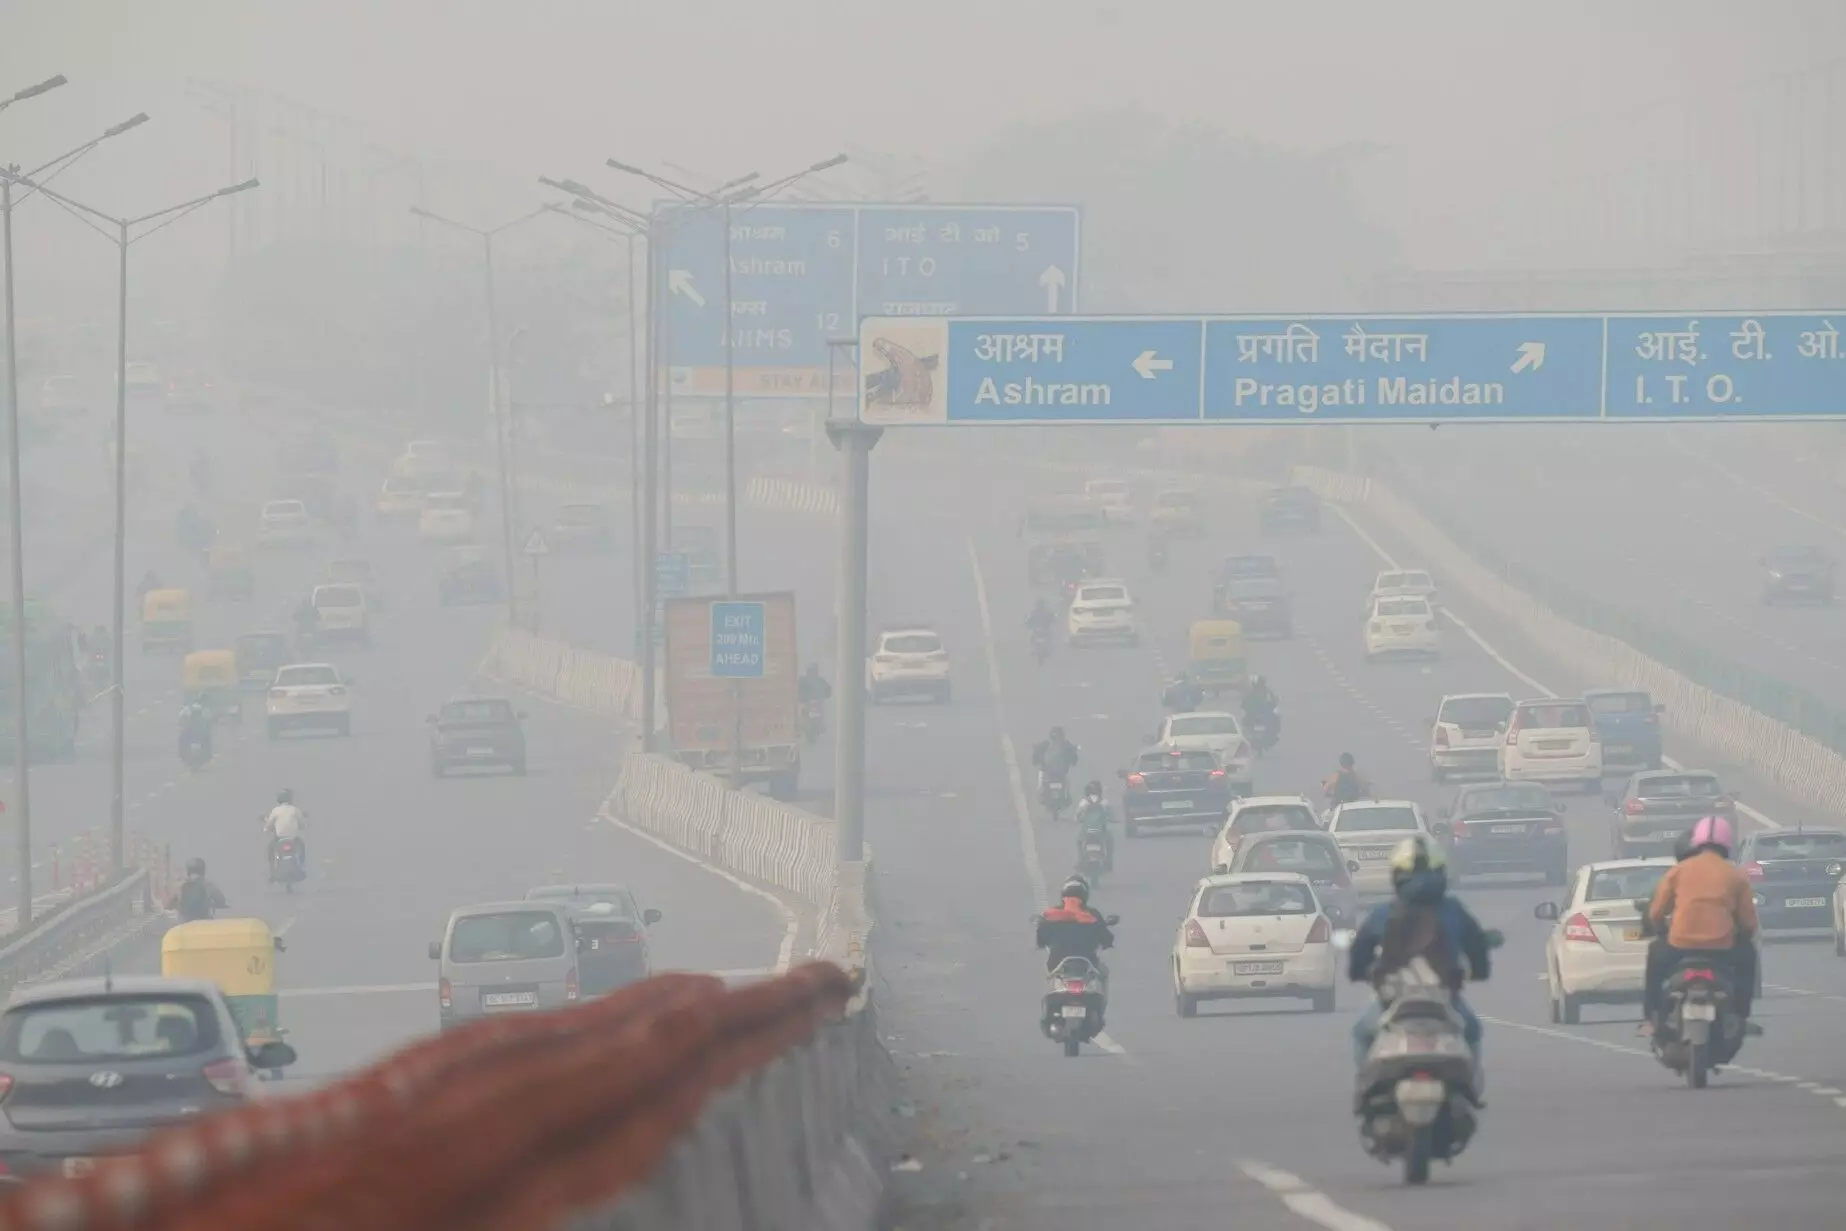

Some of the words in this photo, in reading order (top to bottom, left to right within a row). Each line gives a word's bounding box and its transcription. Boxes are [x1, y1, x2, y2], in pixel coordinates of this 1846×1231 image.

[828, 230, 841, 249] 6
[1015, 233, 1030, 251] 5
[722, 254, 806, 277] Ashram
[816, 312, 840, 331] 12
[974, 334, 1065, 363] आश्रम
[1236, 323, 1320, 363] प्रगति
[1342, 322, 1428, 363] मैदान
[760, 372, 803, 389] STAY
[974, 376, 1111, 405] Ashram
[1235, 377, 1365, 413] Pragati
[1378, 376, 1504, 405] Maidan
[724, 615, 752, 628] EXIT
[715, 653, 760, 665] AHEAD
